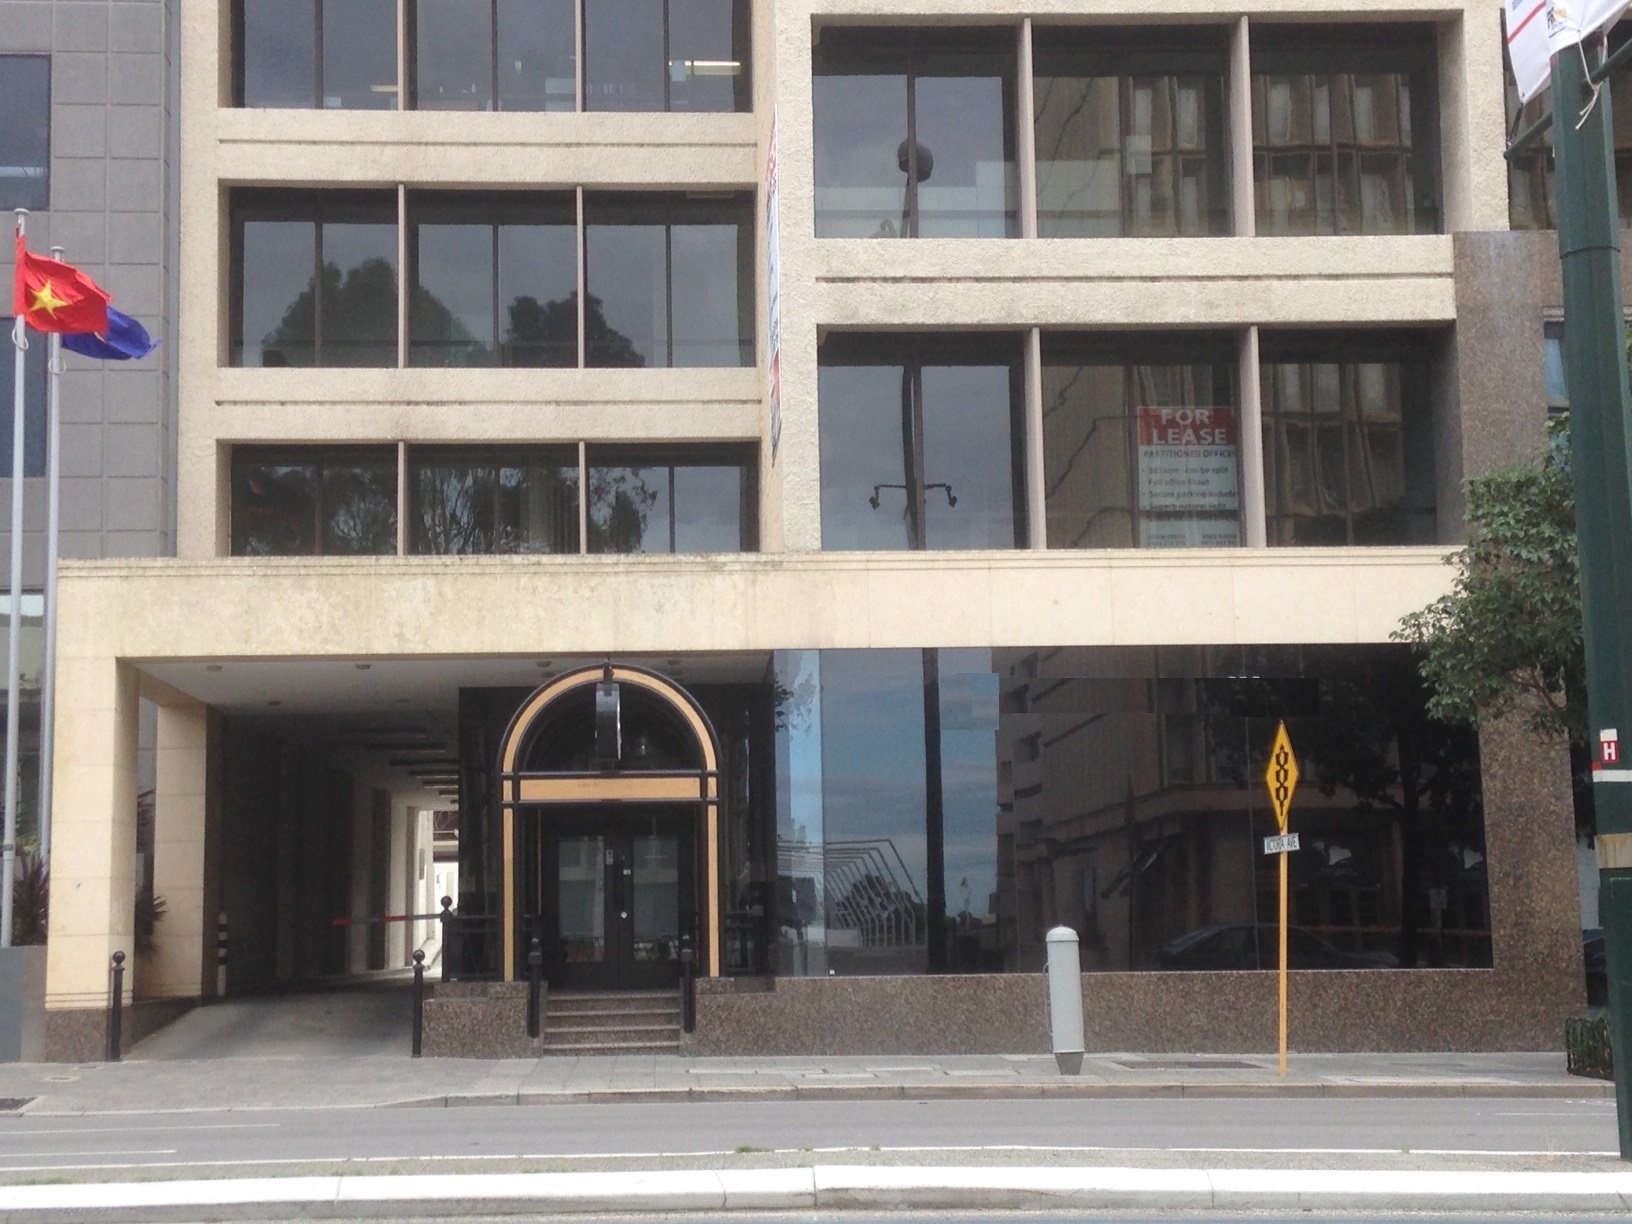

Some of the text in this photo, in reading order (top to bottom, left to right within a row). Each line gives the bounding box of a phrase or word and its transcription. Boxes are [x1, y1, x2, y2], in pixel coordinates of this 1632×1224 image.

[1161, 409, 1210, 425] FOR
[1152, 428, 1227, 444] LEASE
[1603, 742, 1616, 760] H
